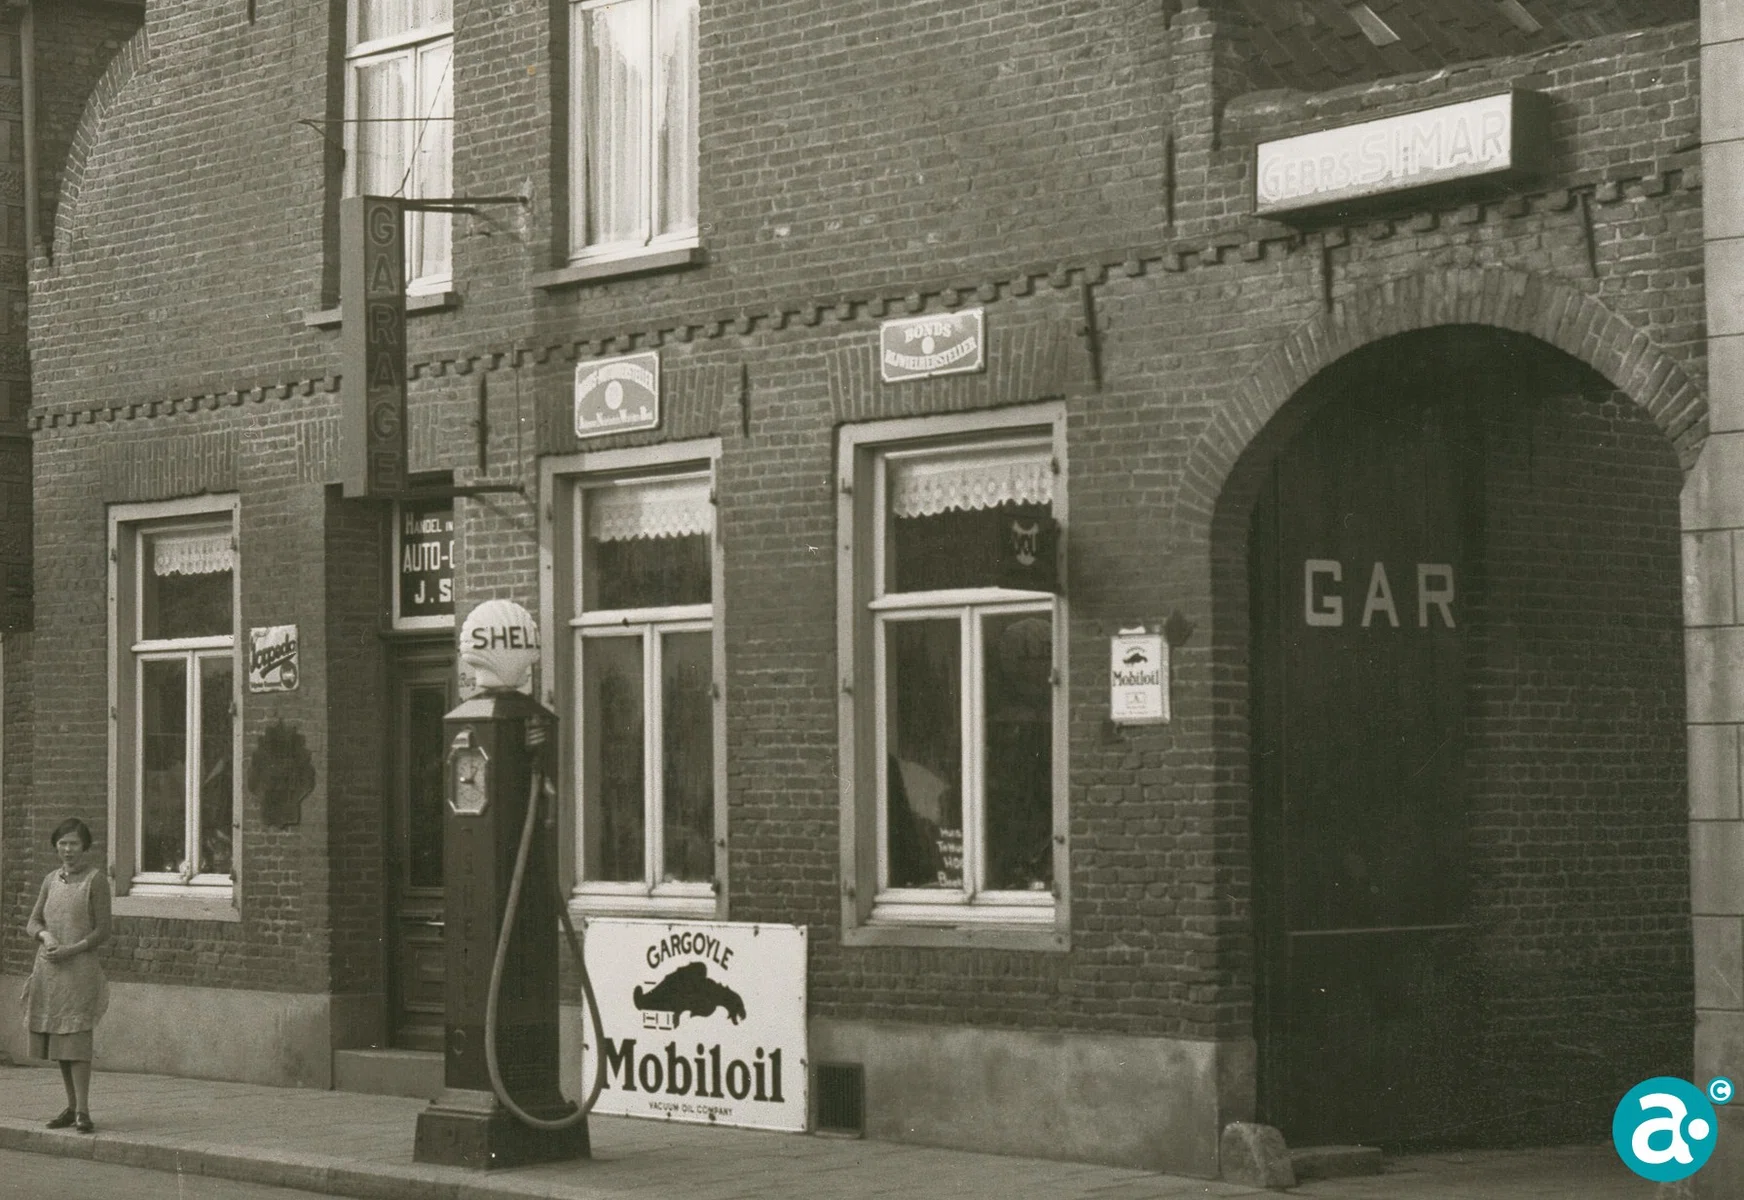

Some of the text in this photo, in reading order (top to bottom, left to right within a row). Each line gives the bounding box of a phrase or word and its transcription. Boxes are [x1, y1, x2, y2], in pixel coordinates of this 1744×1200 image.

[1359, 109, 1507, 182] SIMAR
[367, 204, 400, 493] GARAGE
[405, 512, 442, 535] HANDEL
[1305, 559, 1456, 628] GAR
[471, 626, 541, 650] SHELL
[1112, 669, 1160, 687] Mobiloil
[646, 931, 734, 971] GARGOYLE
[601, 1037, 785, 1103] Mobiloil
[648, 1101, 732, 1116] VACUUM OIL COMPANY
